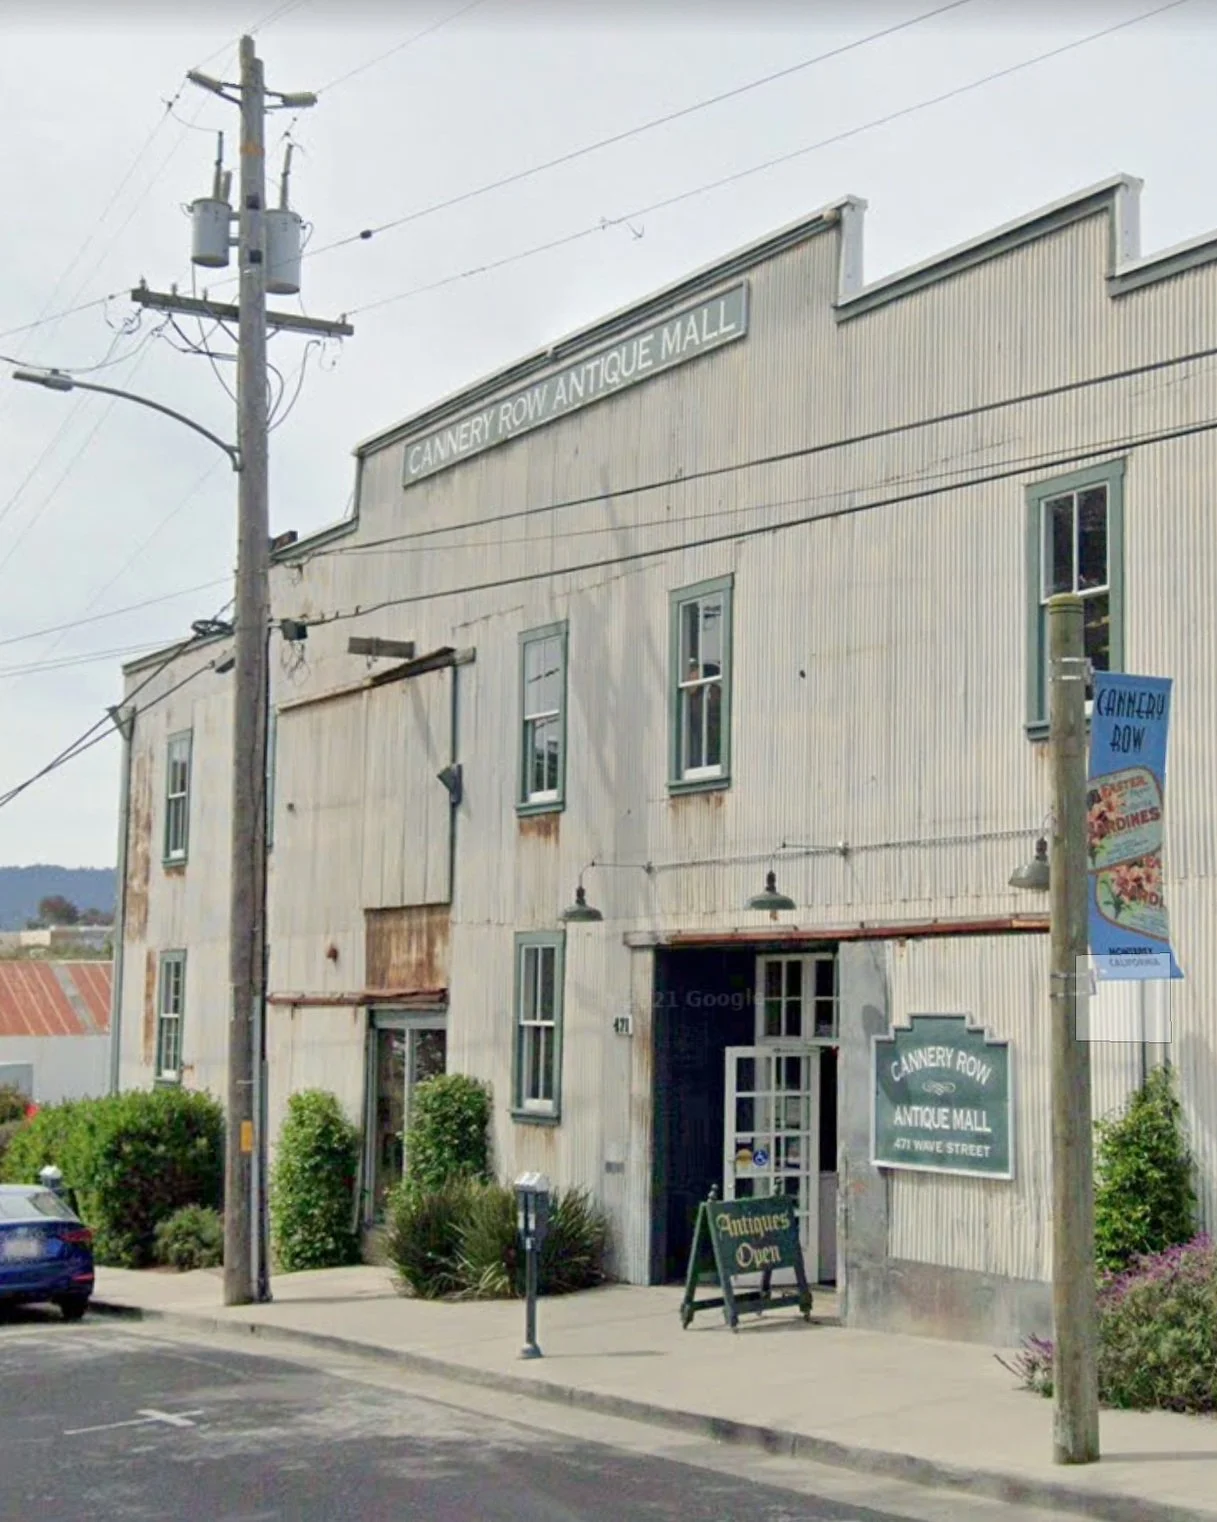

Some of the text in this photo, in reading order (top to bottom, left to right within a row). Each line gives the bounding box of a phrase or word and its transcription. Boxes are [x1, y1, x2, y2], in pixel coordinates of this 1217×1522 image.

[408, 301, 737, 475] CANNERY ROW ANTIQUE MALL
[1097, 688, 1165, 720] CANNERY
[1110, 724, 1146, 753] ROW
[1109, 958, 1160, 967] CALIFORNIA
[613, 1016, 630, 1033] 471
[891, 1046, 992, 1085] CANNERY ROW
[893, 1105, 992, 1132] ANTIQUE MALL
[894, 1138, 991, 1158] 471 WAVE STREET
[716, 1211, 790, 1237] Antiques
[735, 1241, 781, 1269] Open
